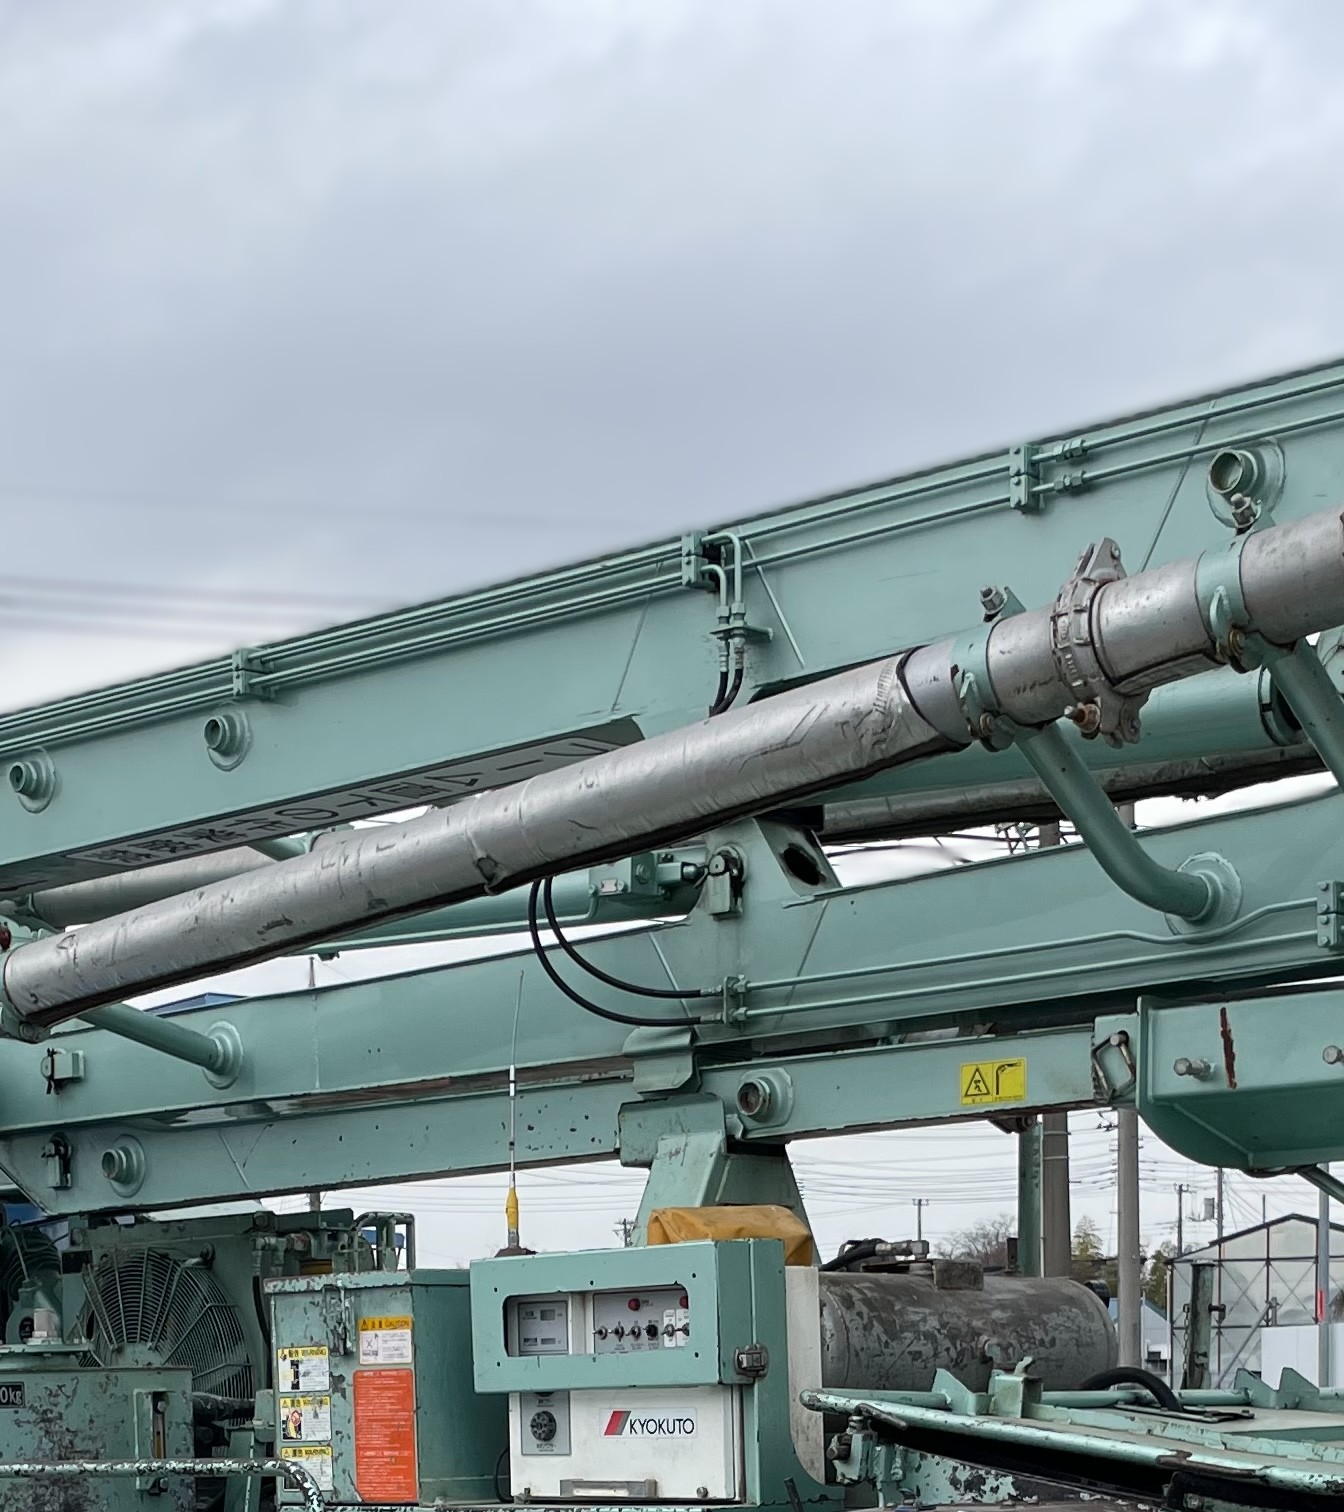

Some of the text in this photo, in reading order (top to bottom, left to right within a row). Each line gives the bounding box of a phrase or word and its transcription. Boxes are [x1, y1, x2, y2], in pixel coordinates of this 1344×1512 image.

[385, 1319, 410, 1327] CAUTION
[629, 1418, 695, 1435] KYOKUTO
[304, 1448, 330, 1456] WARNING
